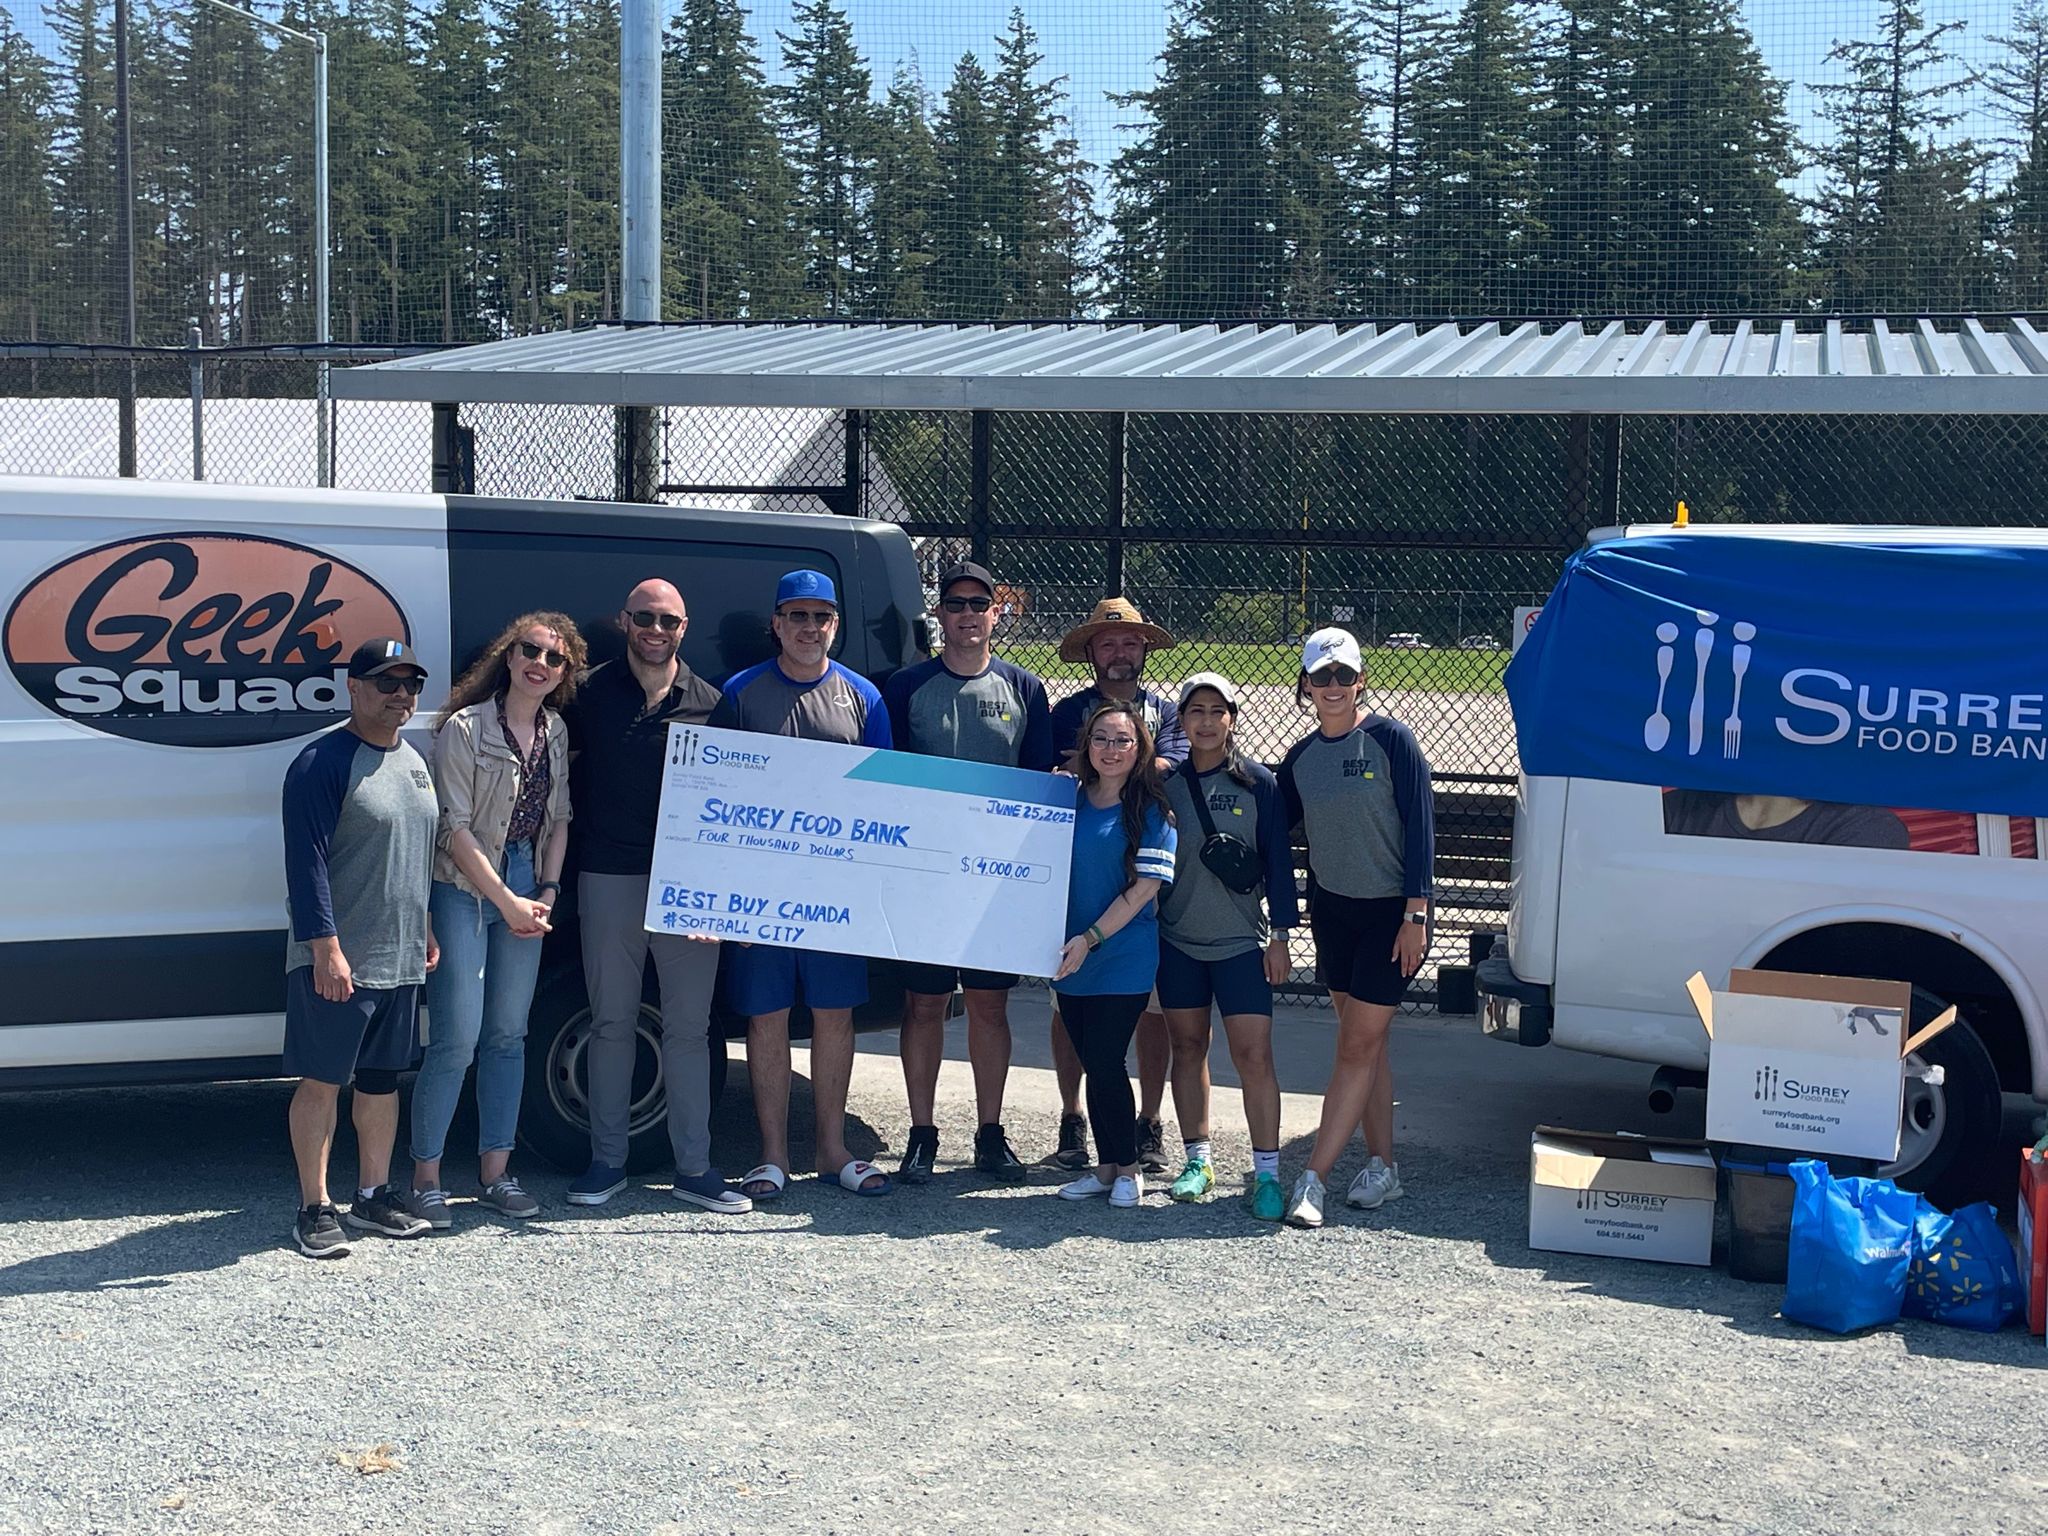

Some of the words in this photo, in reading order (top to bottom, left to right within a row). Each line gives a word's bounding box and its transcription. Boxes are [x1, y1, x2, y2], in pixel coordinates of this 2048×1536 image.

[65, 542, 344, 665] Geek
[54, 666, 352, 713] Squad
[979, 700, 1007, 710] BEST
[1775, 668, 2044, 745] SURRE
[981, 709, 1004, 719] BUY
[1857, 726, 1958, 755] FOOD
[1971, 734, 2047, 761] BAN
[701, 745, 772, 765] SURREY
[720, 760, 743, 769] FOOD
[744, 763, 767, 772] BANK
[1342, 759, 1372, 769] BEST
[1343, 768, 1368, 778] BUY
[1210, 794, 1240, 803] BEST
[1210, 802, 1236, 812] BUY
[986, 800, 1023, 817] JUNE
[700, 798, 785, 831] SURREY
[790, 811, 843, 838] FOOD
[850, 818, 911, 847] BANK
[697, 829, 730, 844] FOUR
[738, 834, 801, 852] THOUSAND
[960, 856, 970, 873] $
[661, 886, 718, 911] BEST
[728, 893, 769, 916] BUY
[778, 901, 851, 925] CANADA
[663, 911, 750, 935] #SOFTBALL
[758, 924, 805, 943] CITY
[1783, 1080, 1851, 1099] SURREY
[1800, 1094, 1822, 1103] FOOD
[1824, 1097, 1846, 1105] BANK
[1762, 1108, 1841, 1124] surreyfoodbank.org
[1604, 1191, 1668, 1208] SURREY
[1620, 1203, 1642, 1212] FOOD
[1643, 1205, 1664, 1213] BANK
[1584, 1217, 1659, 1232] surreyfoodbank.org
